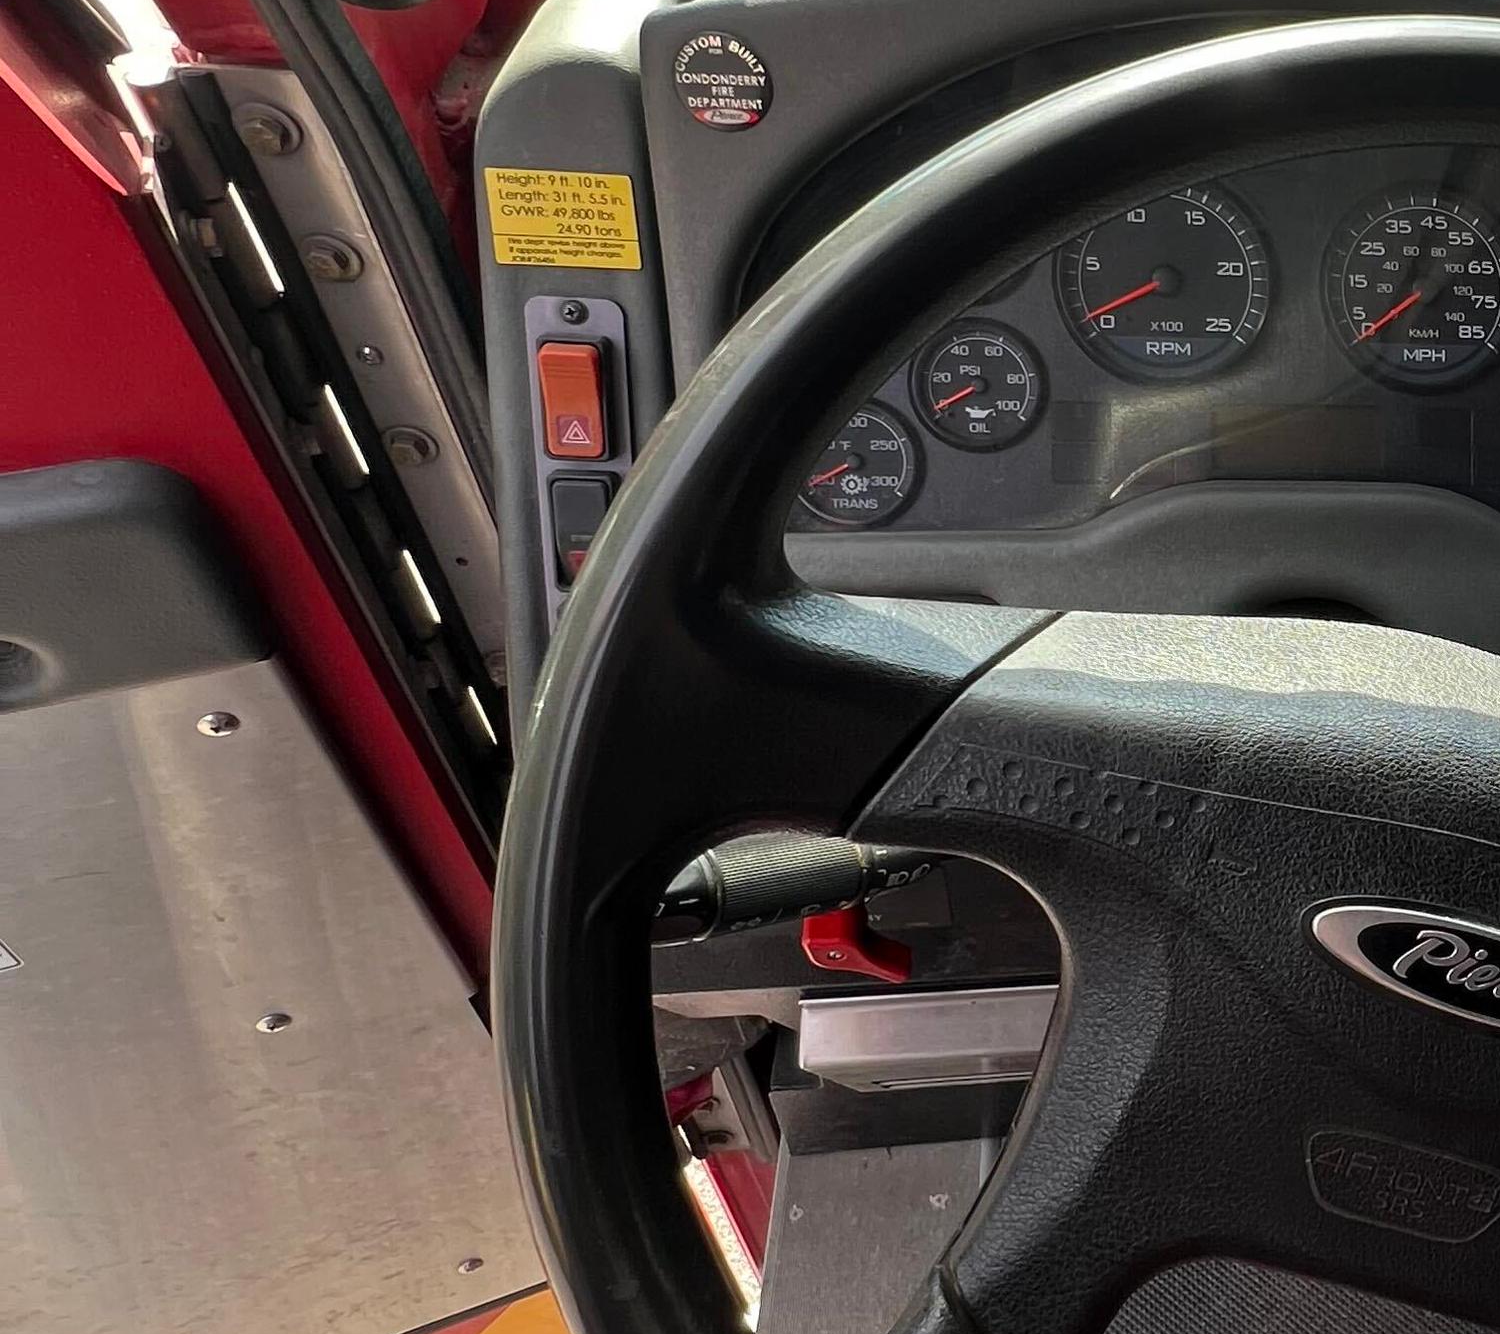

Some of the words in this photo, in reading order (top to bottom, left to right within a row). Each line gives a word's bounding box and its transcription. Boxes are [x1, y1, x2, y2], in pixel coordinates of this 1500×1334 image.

[674, 35, 722, 72] CUSTOM
[728, 40, 765, 74] BUILT
[675, 72, 766, 87] LONDONDERRY
[711, 86, 735, 97] FIRE
[688, 96, 763, 110] DEPARTMENT
[496, 172, 545, 188] Height:
[548, 175, 556, 186] 9
[578, 177, 592, 189] 10
[499, 189, 549, 203] Length:
[553, 192, 567, 203] 31
[589, 194, 608, 206] 5.5
[552, 208, 595, 221] 49,800
[598, 210, 616, 221] lbs
[1185, 211, 1206, 225] 15
[556, 223, 591, 236] 24.90
[594, 225, 622, 237] tons
[1385, 219, 1412, 234] 35
[1420, 216, 1448, 230] 45
[1448, 232, 1474, 246] 55
[1360, 242, 1386, 256] 25
[1403, 246, 1420, 257] 60
[1086, 257, 1100, 271] 5
[1216, 262, 1243, 276] 20
[1382, 261, 1399, 271] 40
[1444, 263, 1464, 274] 100
[1468, 261, 1494, 275] 65
[1349, 274, 1368, 288] 15
[1376, 283, 1393, 294] 20
[1452, 286, 1473, 296] 120
[1471, 295, 1498, 309] 75
[1352, 306, 1366, 320] 5
[1444, 312, 1465, 322] 140
[1100, 315, 1115, 329] 0
[1150, 321, 1183, 332] X100
[1205, 318, 1232, 332] 25
[1408, 328, 1440, 338] KM/H
[1458, 325, 1485, 339] 85
[951, 345, 969, 356] 40
[984, 346, 1002, 357] 60
[1146, 341, 1192, 356] RPM
[1403, 348, 1446, 363] MPH
[932, 372, 951, 383] 20
[959, 365, 981, 376] PSI
[1007, 373, 1025, 384] 80
[995, 400, 1021, 411] 100
[848, 417, 868, 427] 00
[969, 422, 991, 433] OIL
[870, 440, 898, 451] 250
[871, 476, 898, 487] 300
[831, 498, 878, 510] TRANS
